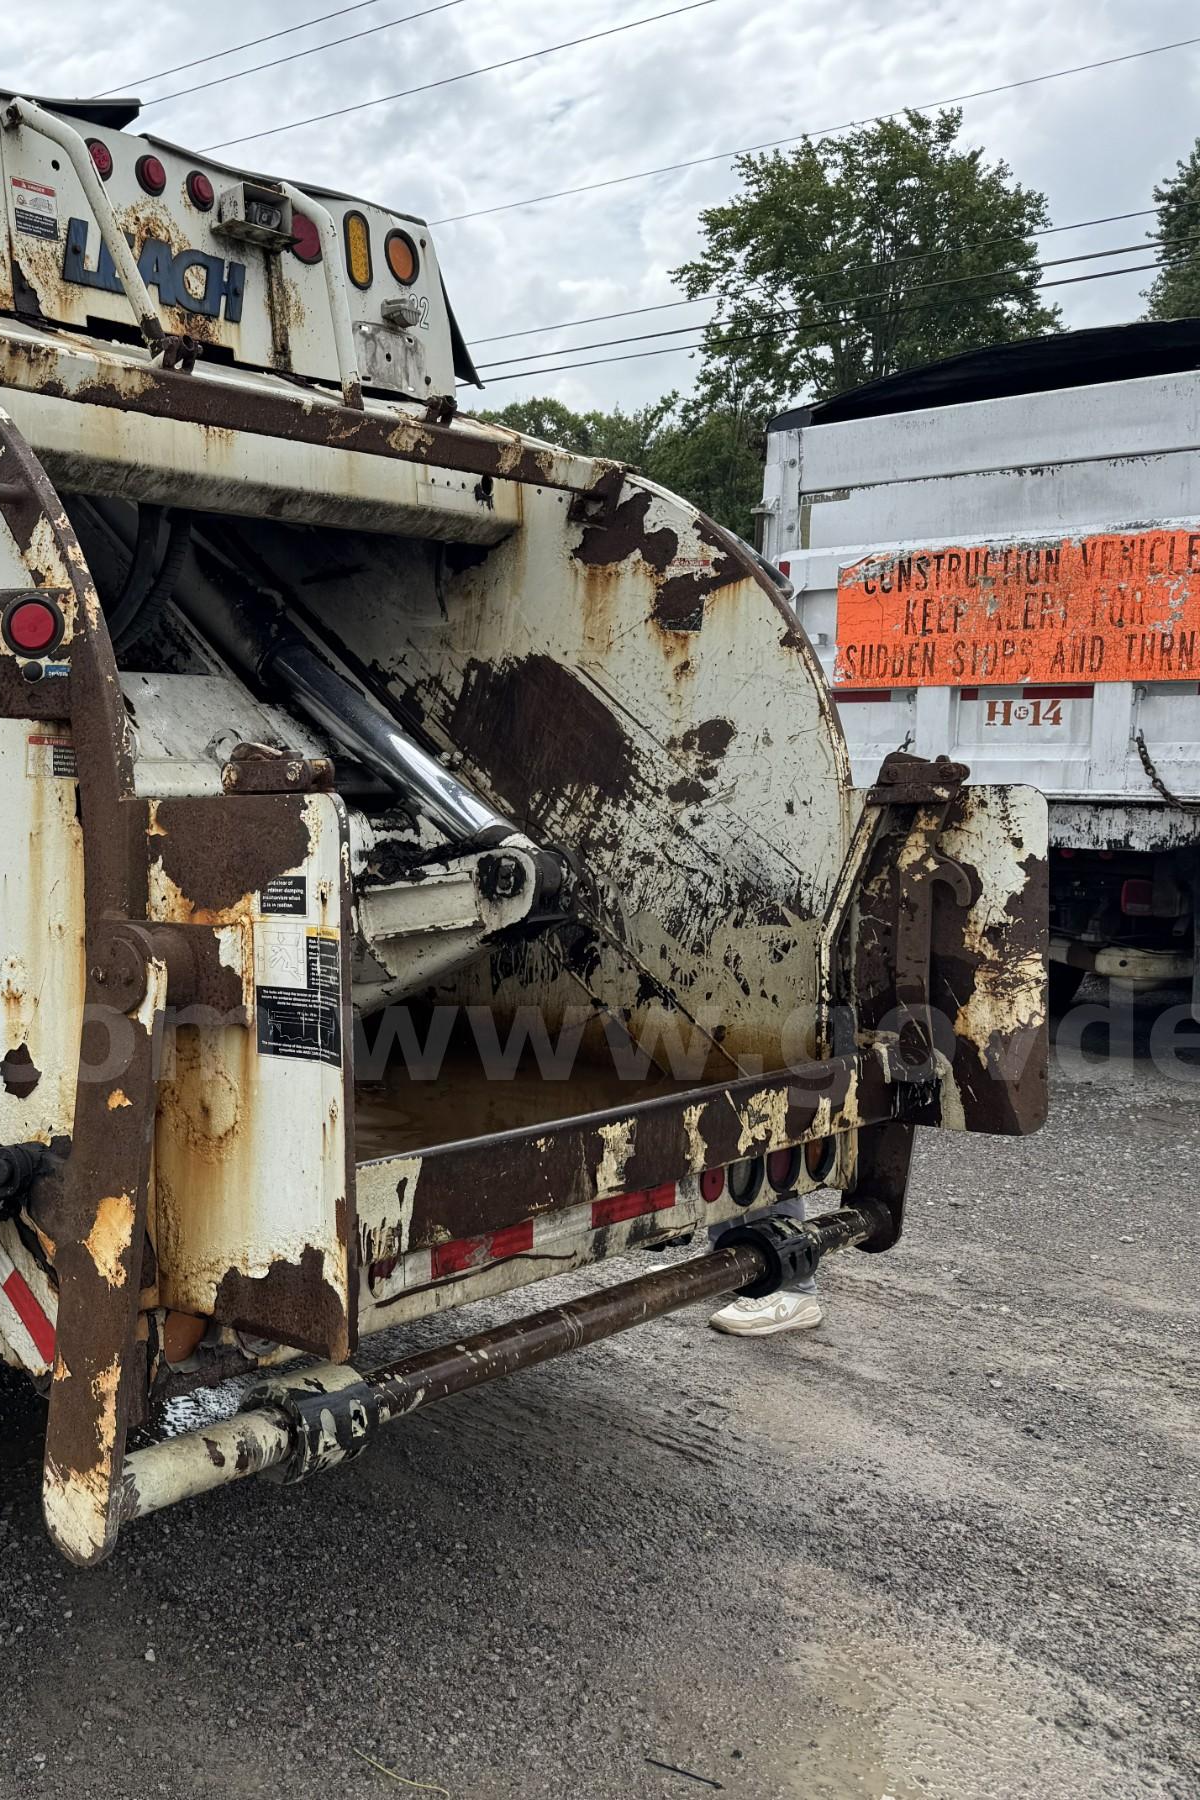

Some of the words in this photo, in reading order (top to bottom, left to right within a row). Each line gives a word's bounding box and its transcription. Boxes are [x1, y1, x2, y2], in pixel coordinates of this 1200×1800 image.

[904, 596, 968, 636] KEEP
[845, 640, 936, 680] SUDDEN
[952, 638, 1033, 677] STOPS
[1050, 635, 1105, 673] AND
